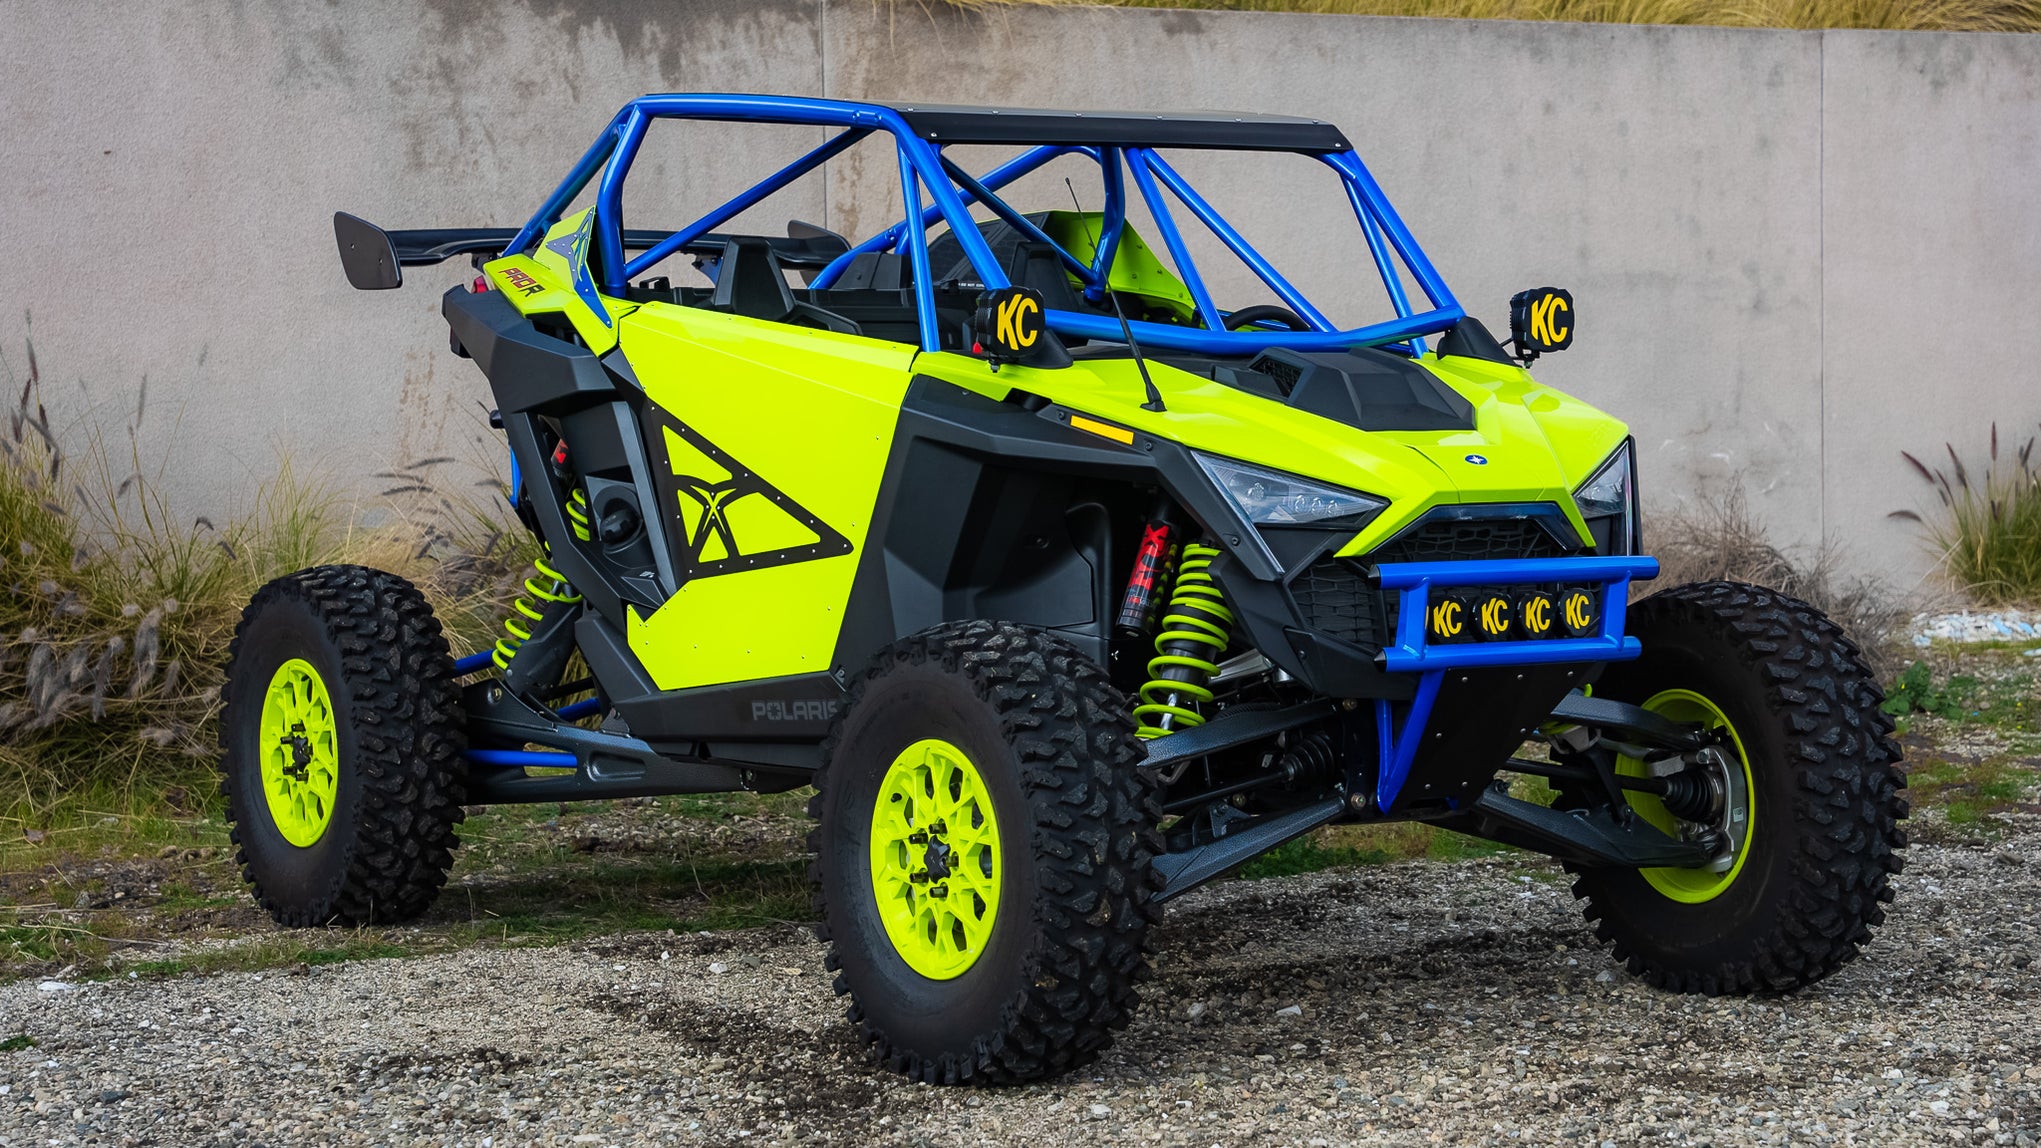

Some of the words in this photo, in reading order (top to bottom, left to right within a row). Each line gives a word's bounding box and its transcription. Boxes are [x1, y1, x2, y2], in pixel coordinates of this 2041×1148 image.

[498, 268, 537, 289] PRO
[997, 294, 1039, 351] KC
[1531, 293, 1568, 347] KC
[1433, 600, 1463, 638] KC
[1481, 598, 1509, 635] KC
[1525, 596, 1551, 633] KC
[1565, 593, 1591, 630] KC
